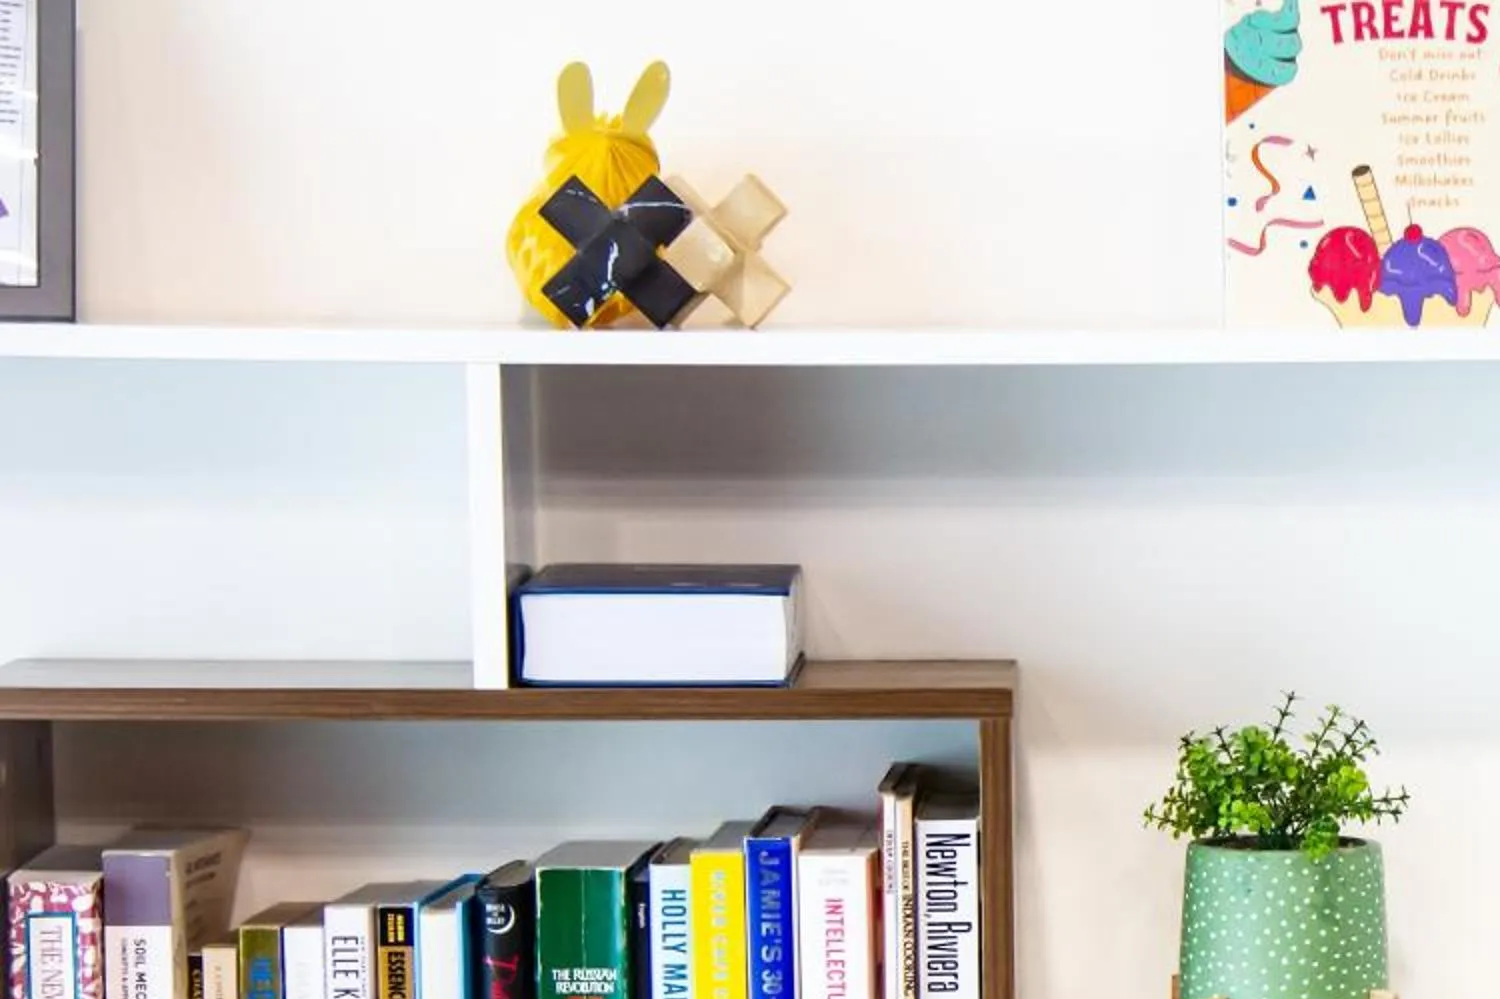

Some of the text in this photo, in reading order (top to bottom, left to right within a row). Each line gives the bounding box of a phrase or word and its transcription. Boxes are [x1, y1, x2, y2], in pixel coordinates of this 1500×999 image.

[1321, 0, 1490, 44] TREATS
[1390, 67, 1477, 82] Cold Drinks
[1423, 90, 1470, 103] Cream
[1381, 112, 1438, 125] Summer
[1397, 153, 1472, 168] Smoothies
[1395, 172, 1474, 188] Milkshakes
[900, 841, 911, 859] THE
[660, 888, 689, 954] HOLLY
[758, 851, 784, 964] JAMIE'S
[902, 893, 915, 938] INDIAN
[923, 832, 972, 994] Newton, Riviera
[40, 926, 64, 964] THE
[134, 938, 148, 967] SOIL
[331, 935, 360, 978] ELLE
[552, 967, 617, 981] THE RUSSIAN
[902, 941, 916, 998] COOKING
[556, 981, 615, 994] REVOLUTION
